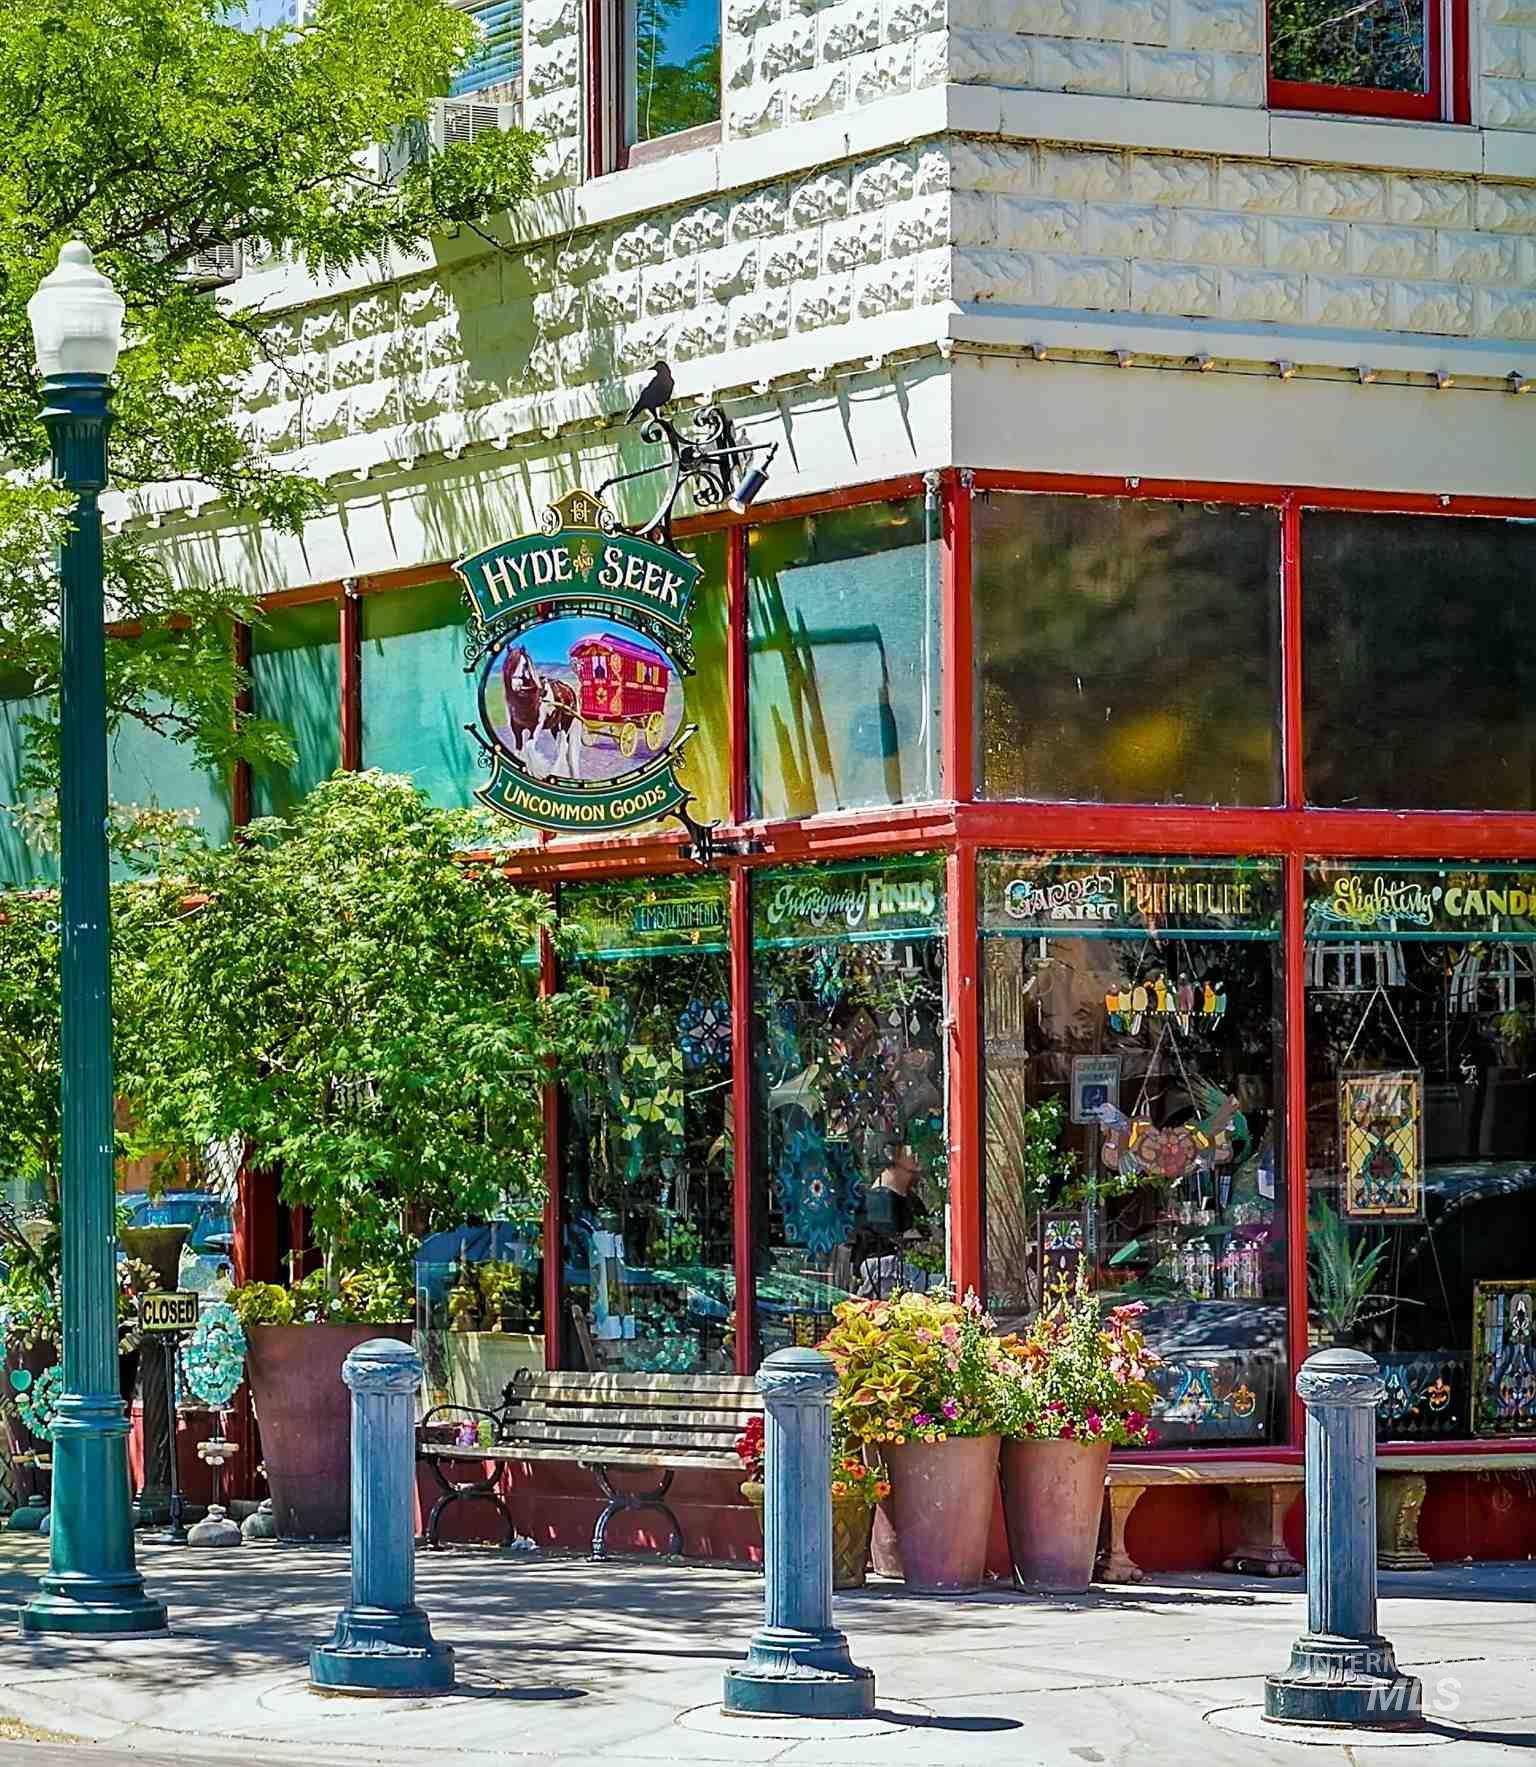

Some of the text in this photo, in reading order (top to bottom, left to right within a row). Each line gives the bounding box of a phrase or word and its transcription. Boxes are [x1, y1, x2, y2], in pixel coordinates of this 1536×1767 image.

[481, 547, 573, 606] HYDE
[598, 546, 685, 607] SEEK
[504, 782, 667, 821] UNCOMMON GOODS
[867, 878, 936, 920] FINDS
[1004, 871, 1116, 919] GARDEN
[1050, 903, 1120, 920] ART
[1332, 875, 1434, 926] Lighting
[143, 1299, 194, 1324] CLOSED
